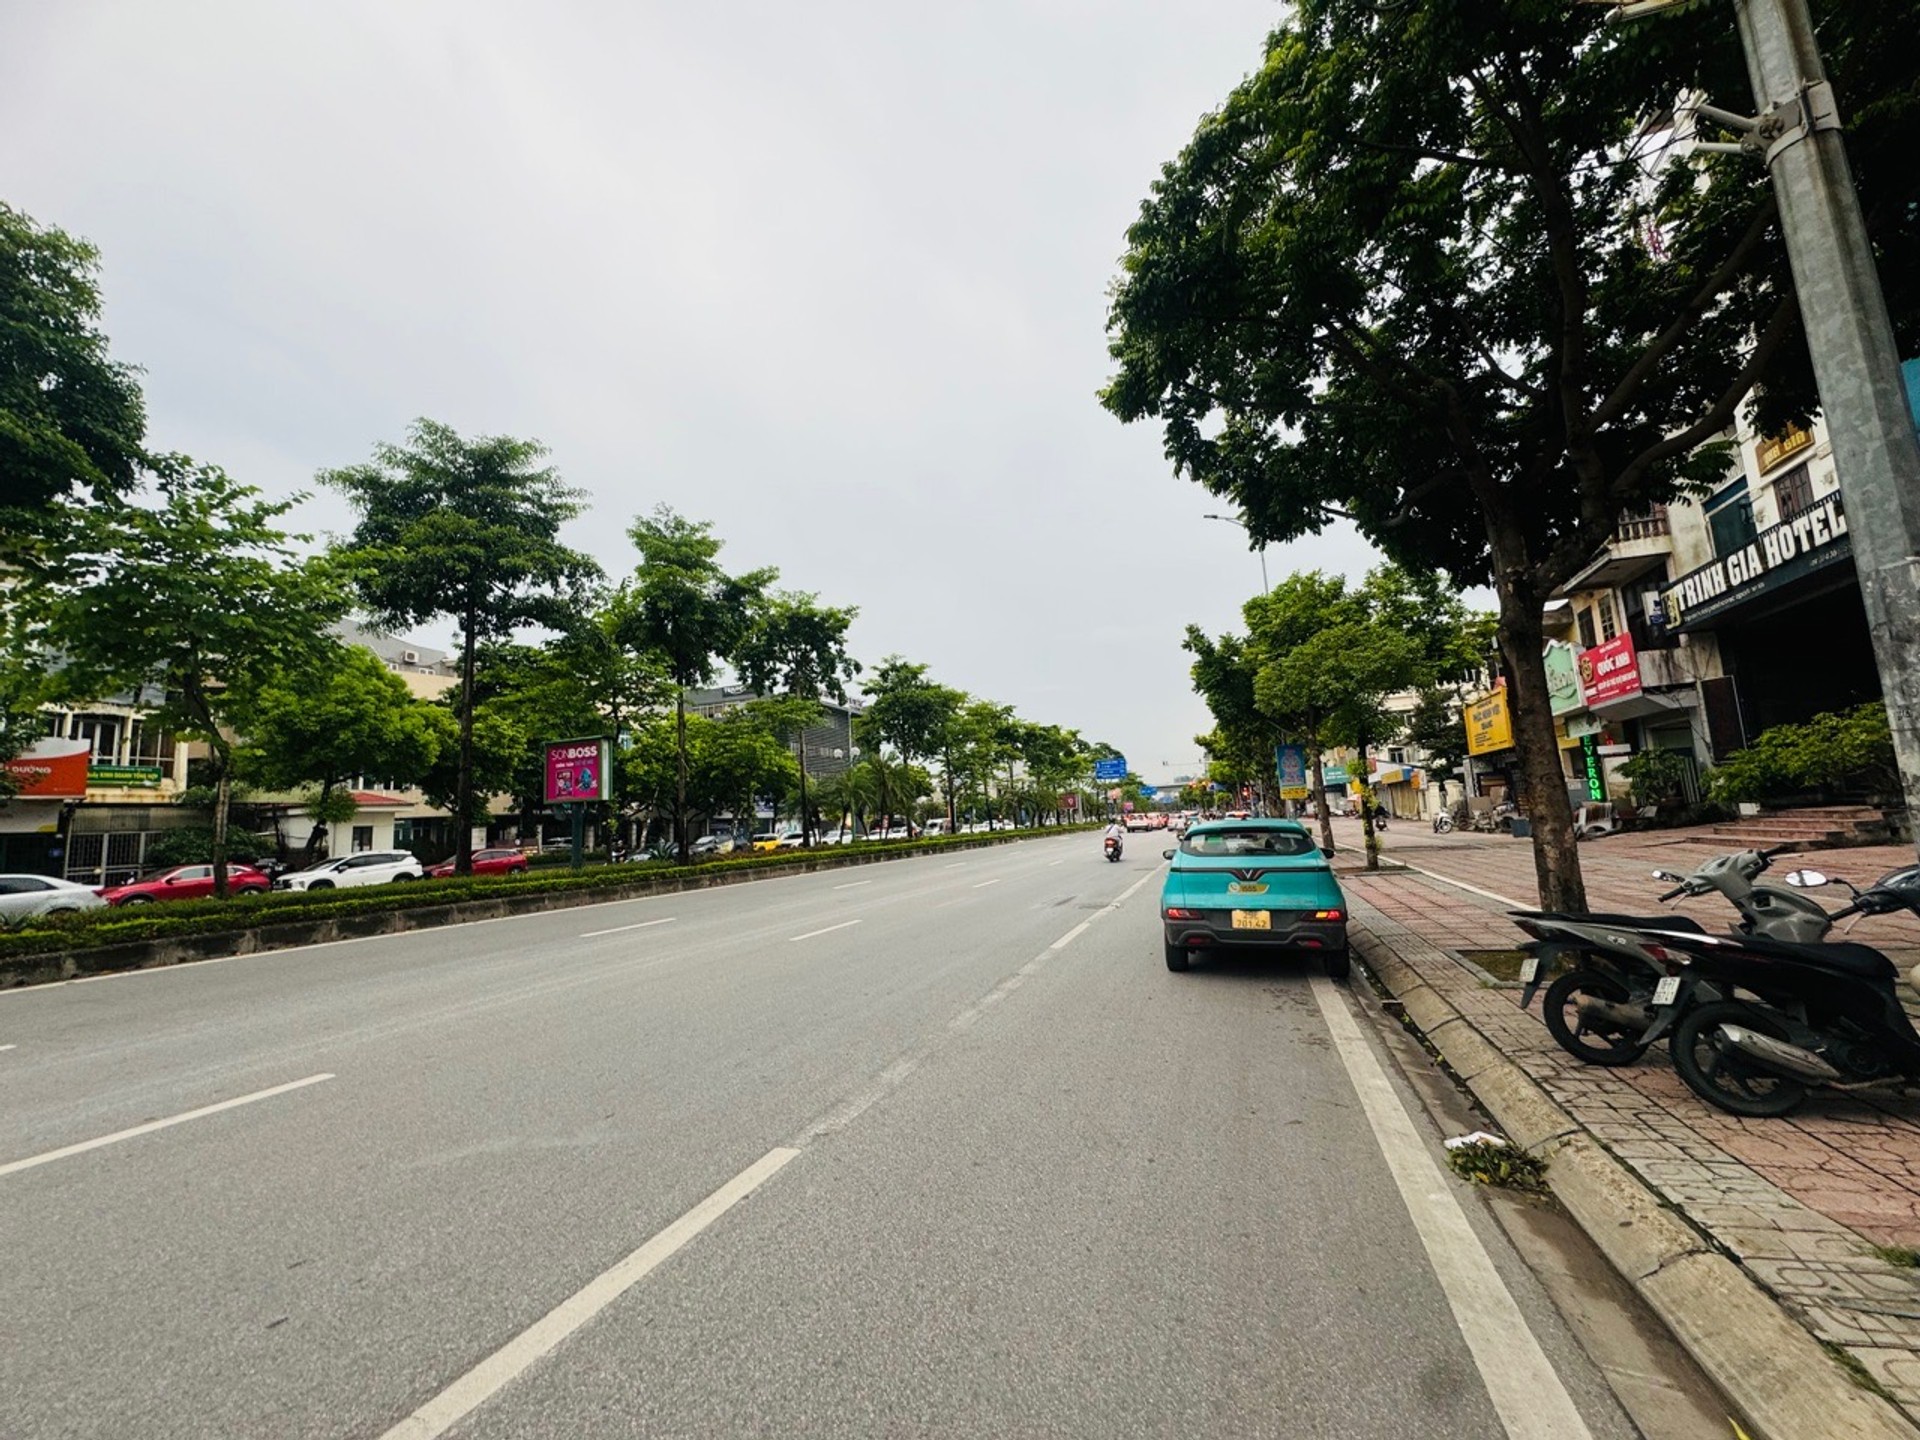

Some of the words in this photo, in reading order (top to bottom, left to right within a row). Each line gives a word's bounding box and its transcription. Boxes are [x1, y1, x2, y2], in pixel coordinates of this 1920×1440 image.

[1726, 543, 1764, 587] GIA
[1763, 500, 1848, 569] HOTEL
[1583, 734, 1602, 800] EVERON
